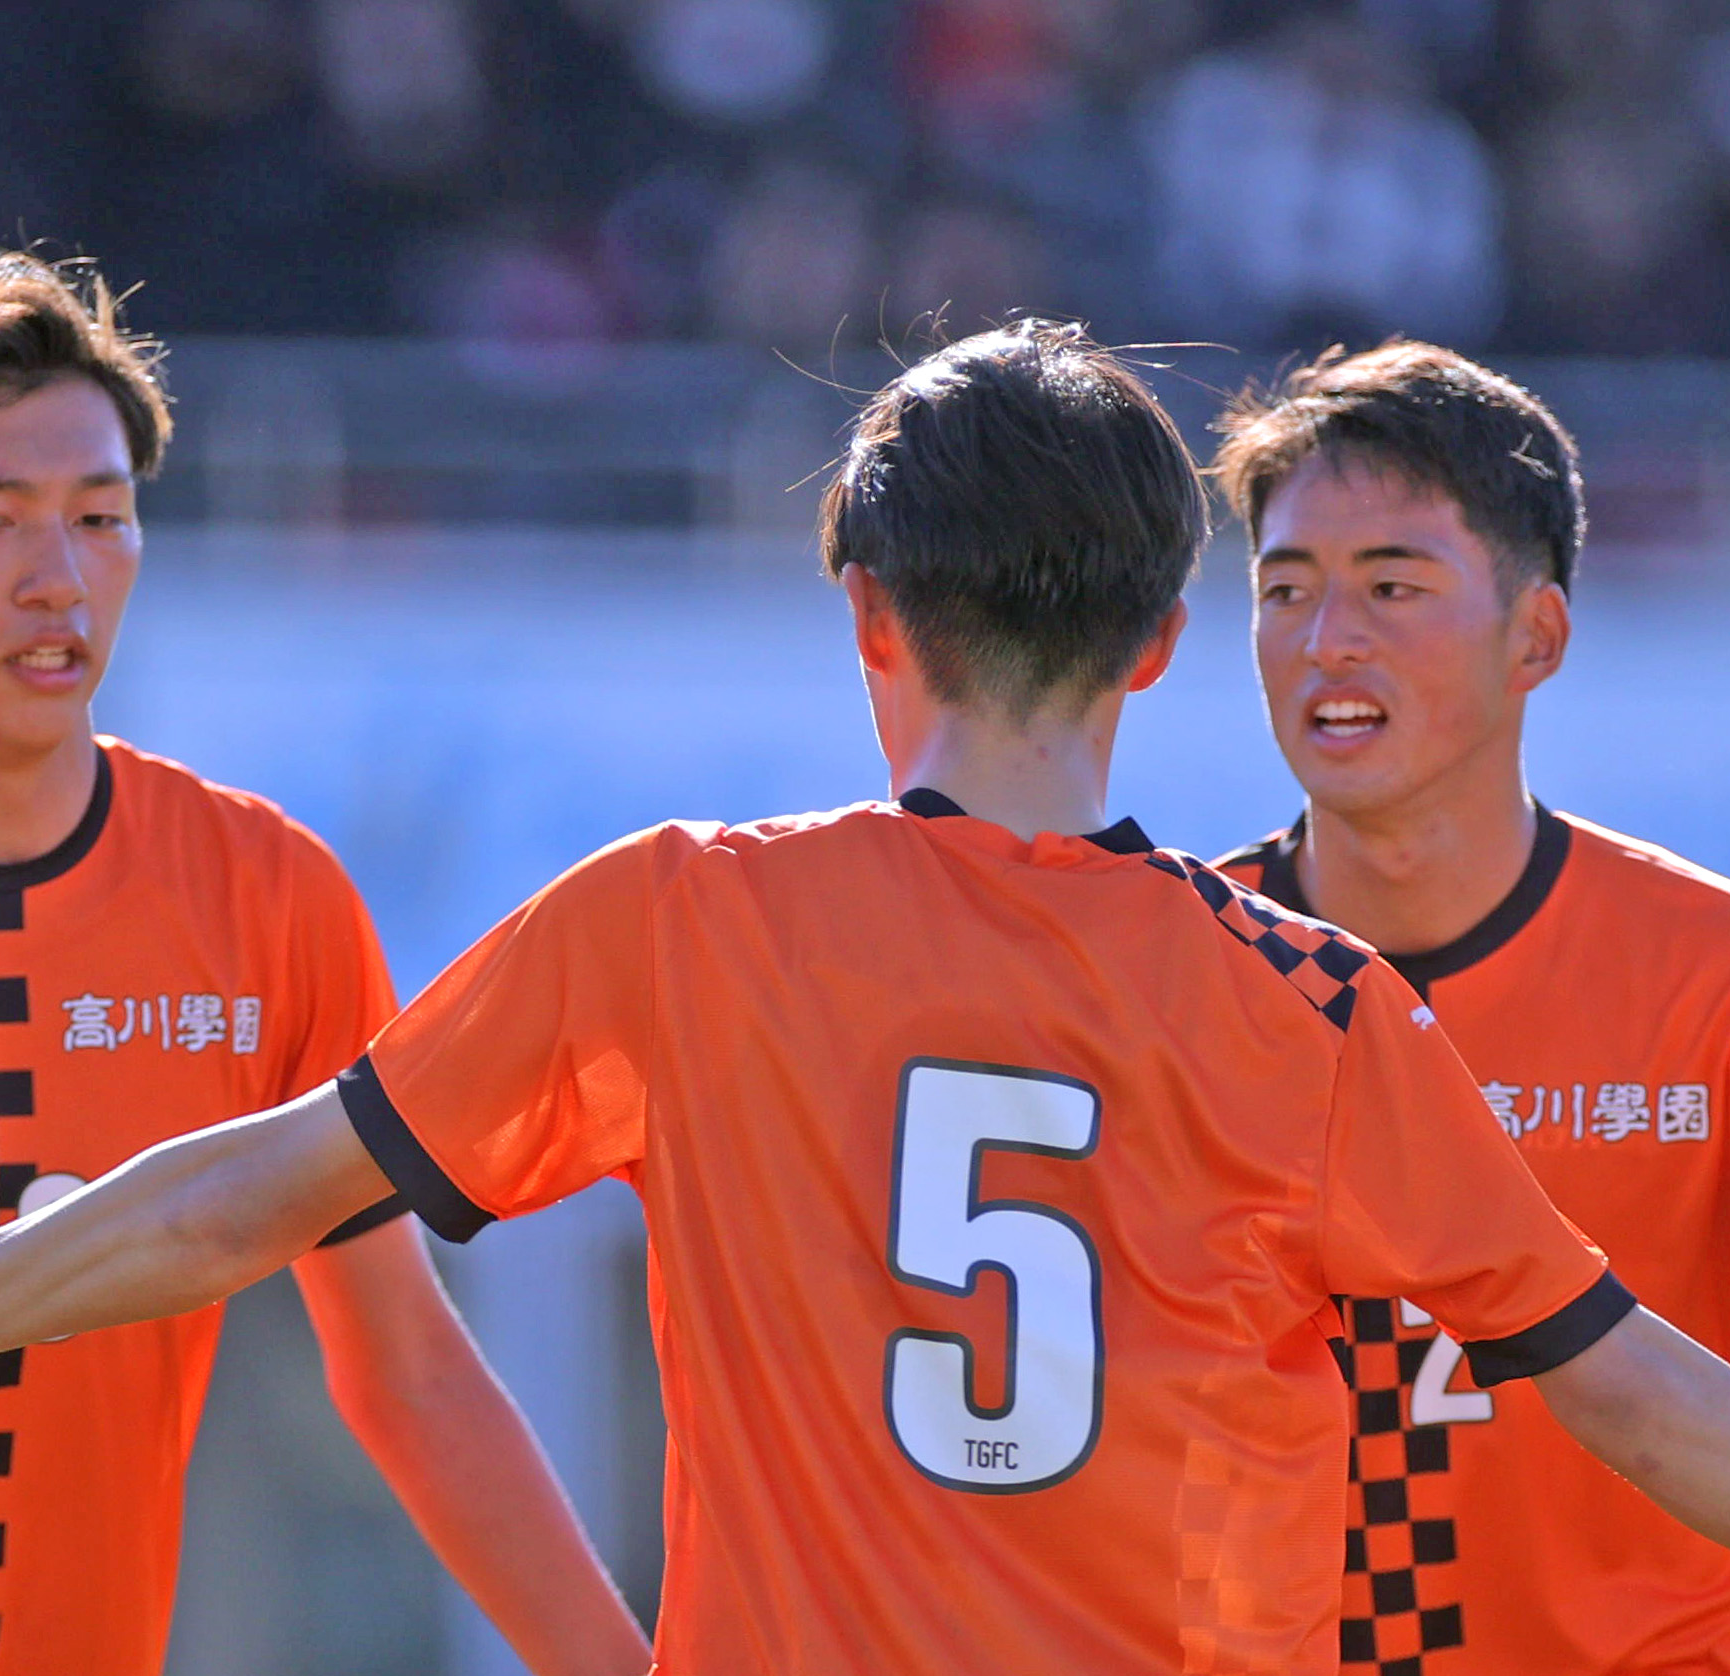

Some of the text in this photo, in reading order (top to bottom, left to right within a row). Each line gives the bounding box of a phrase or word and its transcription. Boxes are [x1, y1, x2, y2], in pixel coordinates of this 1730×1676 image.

[61, 992, 262, 1055] 高川學園
[882, 1055, 1106, 1496] 5
[964, 1438, 1021, 1471] TGFC
